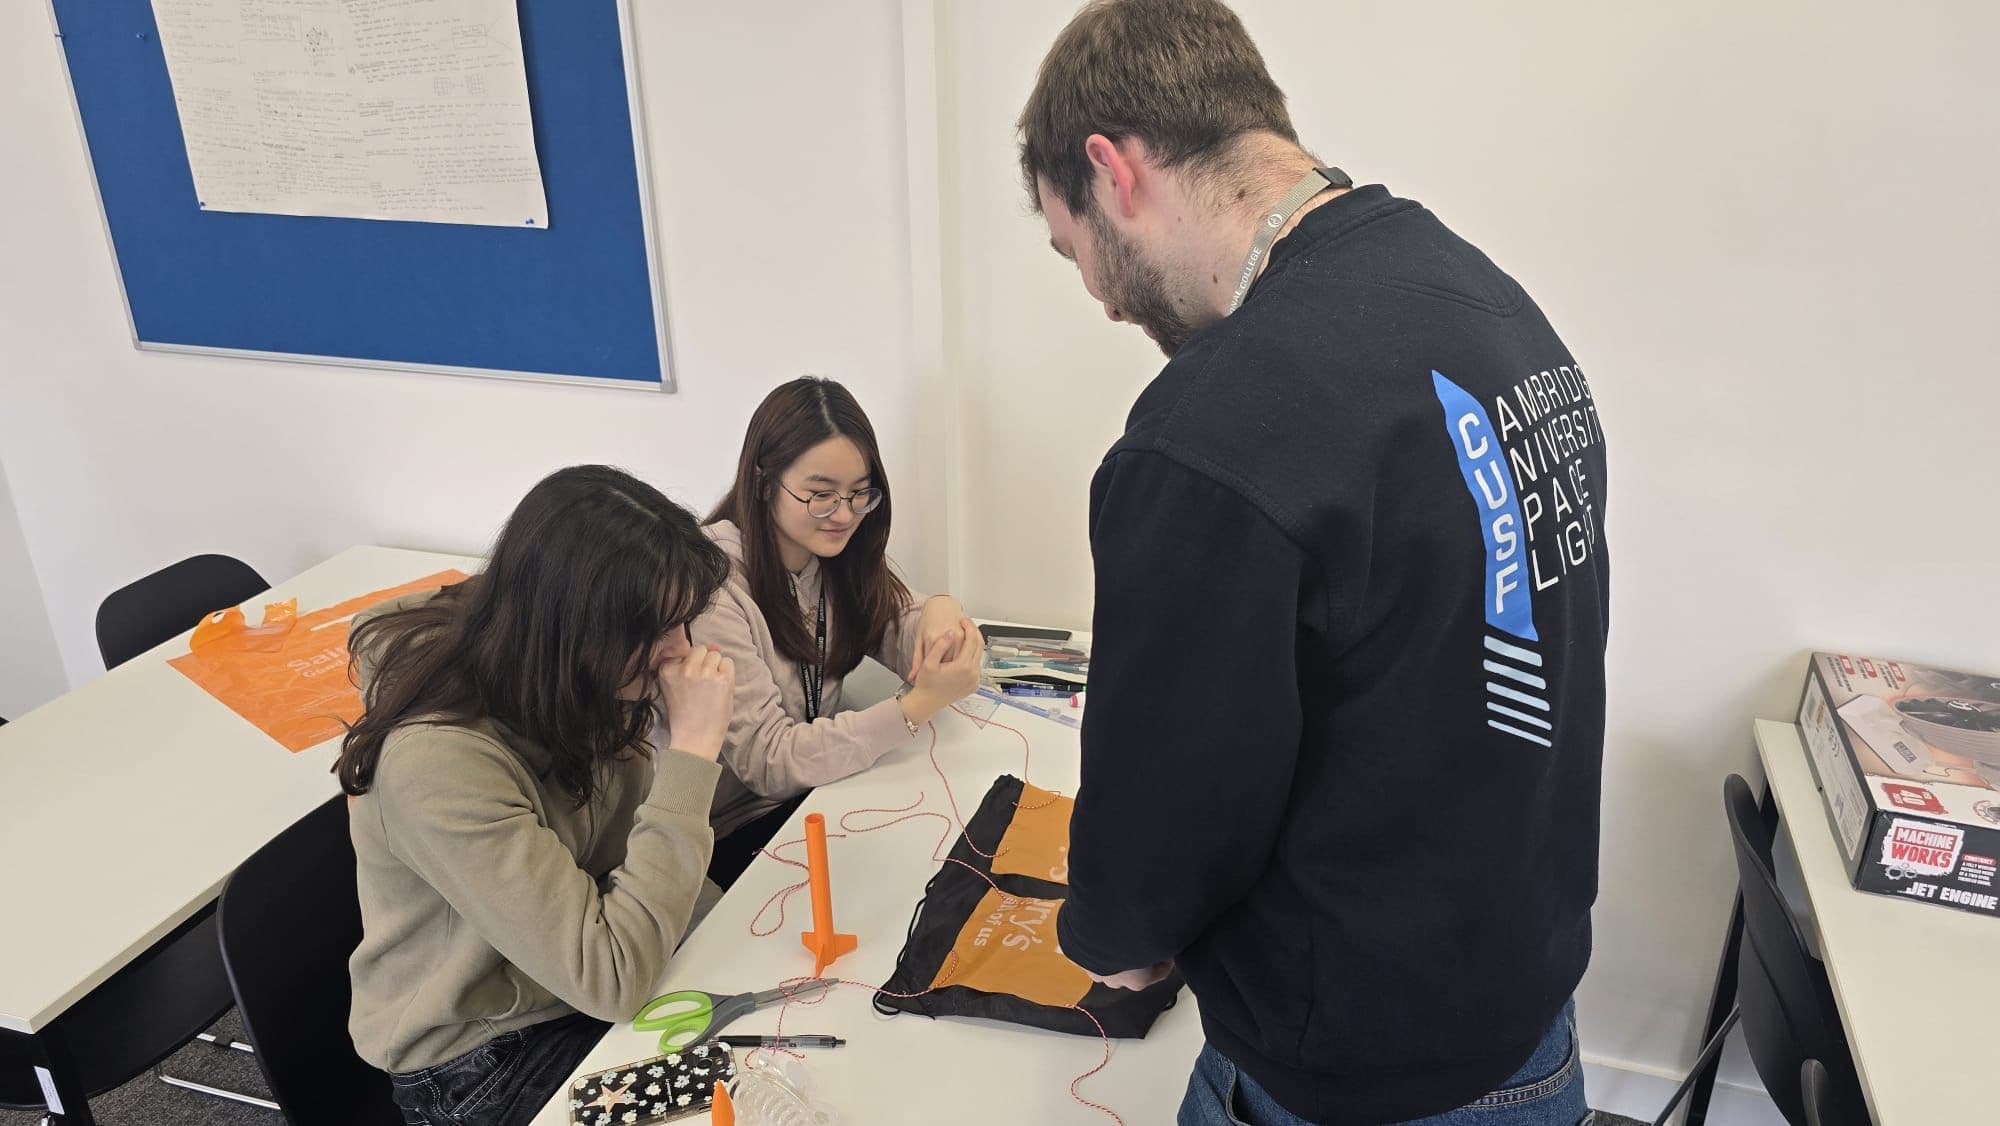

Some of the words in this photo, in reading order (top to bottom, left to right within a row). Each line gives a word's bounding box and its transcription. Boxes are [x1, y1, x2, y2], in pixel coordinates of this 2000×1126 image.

[1240, 246, 1262, 290] COLLEGE
[1496, 364, 1592, 442] AMBRIDG
[1509, 405, 1600, 491] NIVERSIT
[1458, 412, 1519, 615] CUSF
[1522, 458, 1589, 541] PACE
[1891, 842, 1953, 869] WORKS
[1895, 827, 1956, 850] MACHINE
[1904, 881, 1938, 898] JET
[1940, 887, 1999, 910] ENGINE
[974, 927, 993, 946] us
